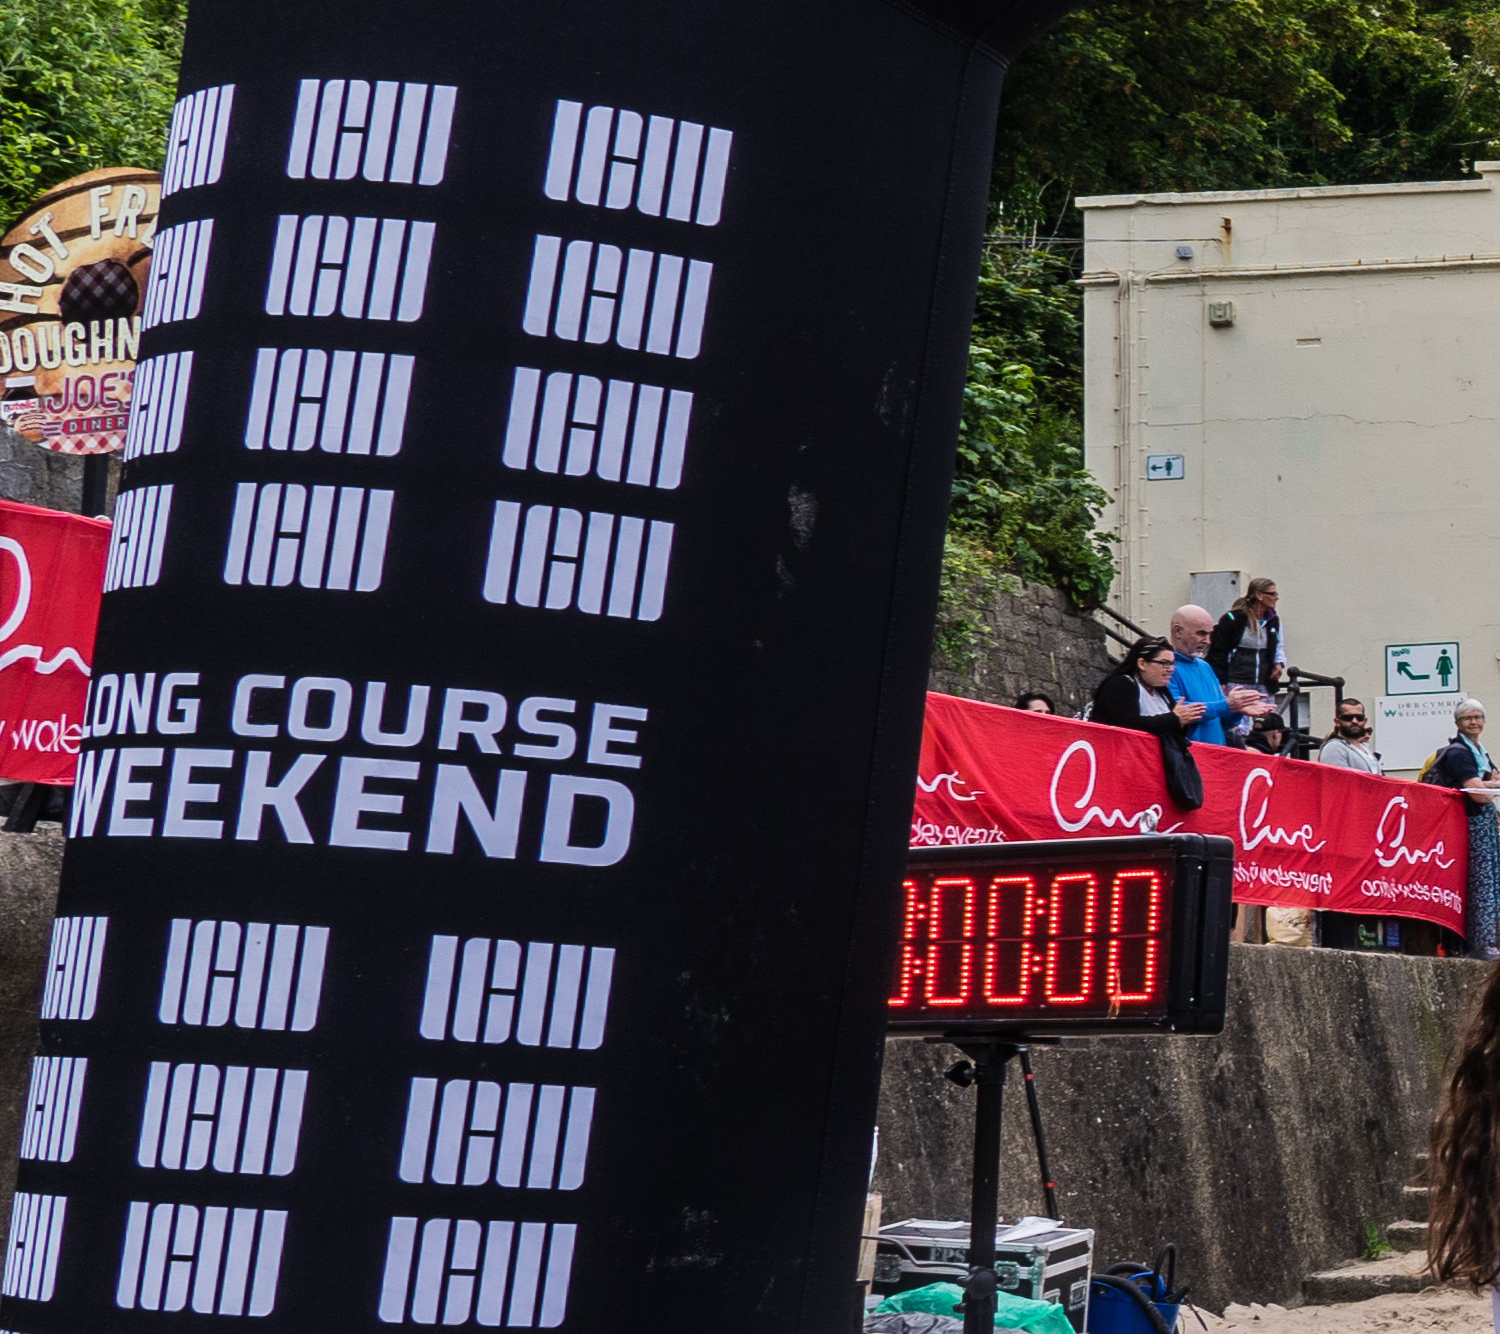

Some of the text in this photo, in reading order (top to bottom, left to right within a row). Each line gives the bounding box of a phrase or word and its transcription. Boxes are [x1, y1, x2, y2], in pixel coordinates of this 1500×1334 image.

[0, 184, 158, 314] HOT FR
[67, 417, 126, 434] DINER
[83, 672, 648, 769] LONG COURSE
[68, 747, 635, 867] WEEKEND
